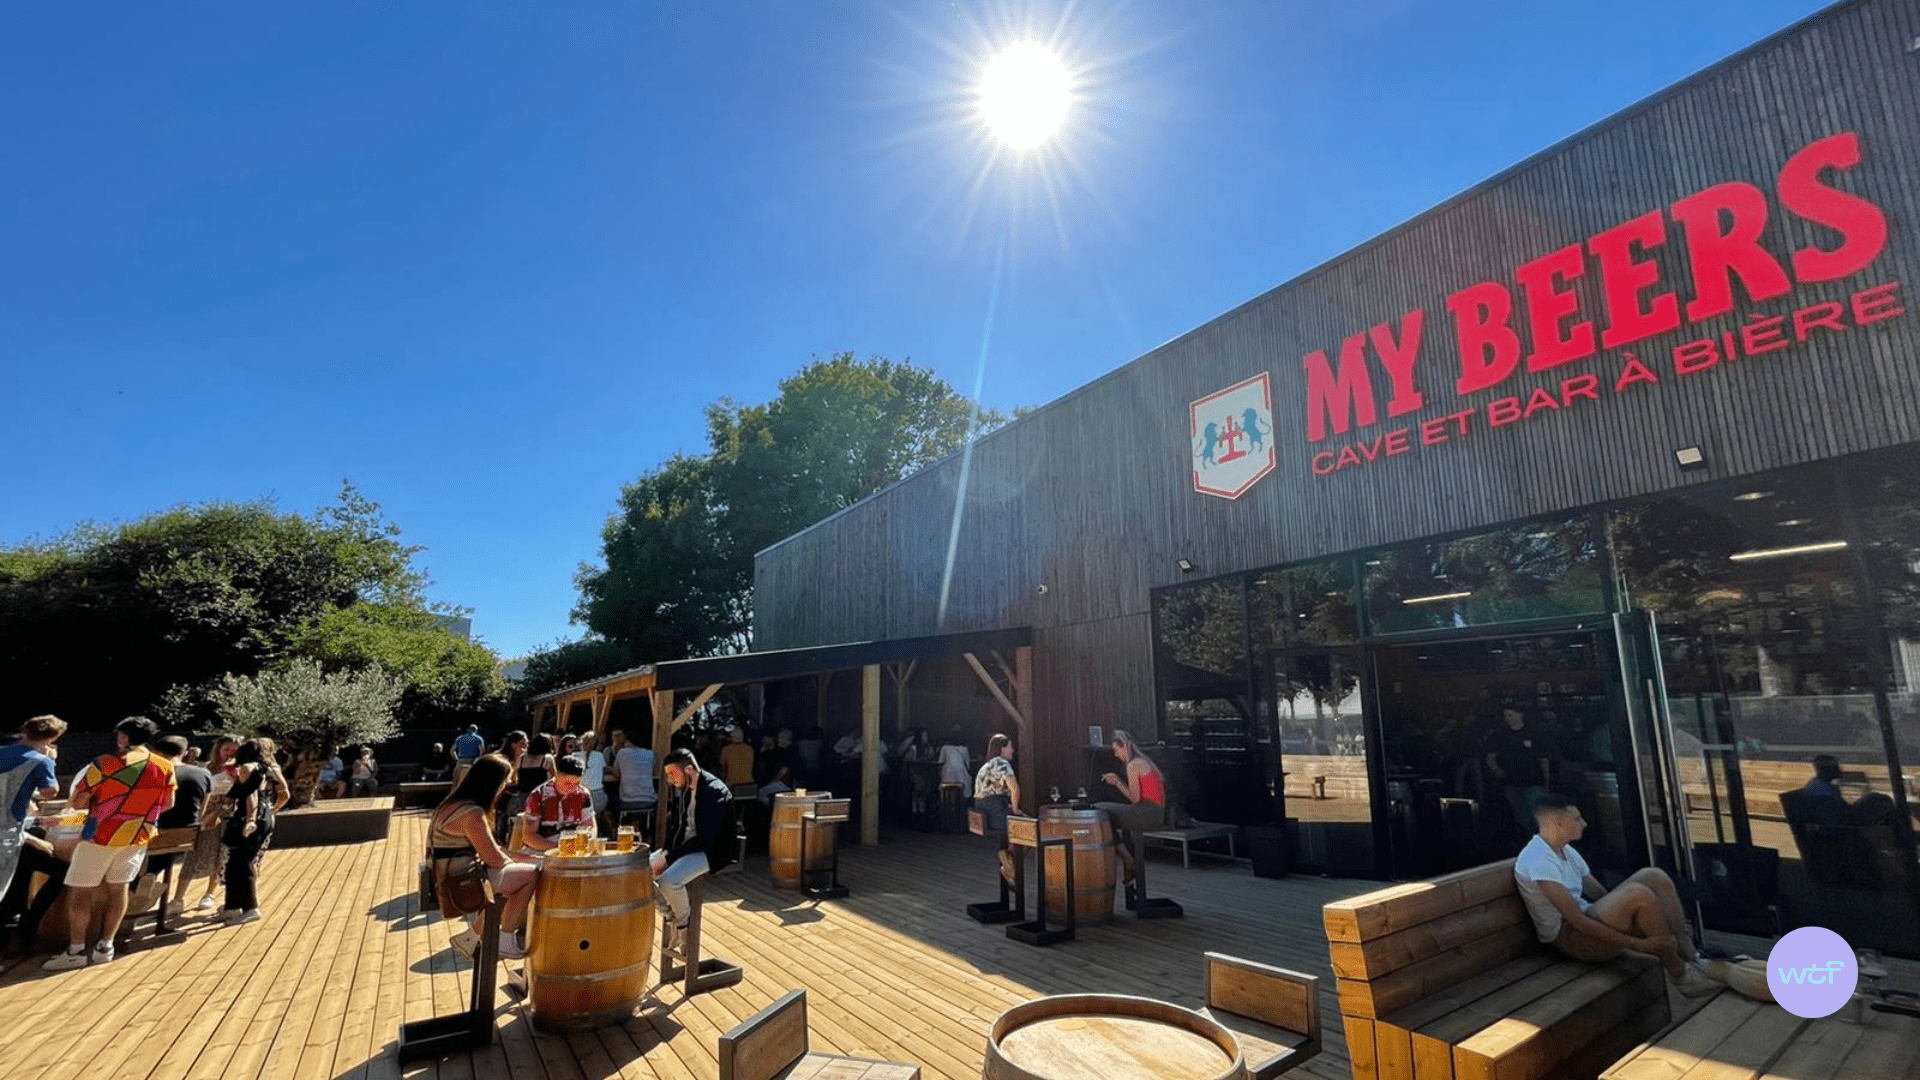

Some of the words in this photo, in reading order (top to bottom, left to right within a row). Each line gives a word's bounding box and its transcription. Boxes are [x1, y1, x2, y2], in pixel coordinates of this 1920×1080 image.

[1303, 308, 1426, 443] MY
[1446, 131, 1889, 397] BEERS
[1311, 426, 1411, 476] CAVE
[1421, 407, 1477, 448] ET
[1487, 373, 1601, 429] BAR
[1614, 350, 1659, 394] À
[1672, 282, 1905, 377] BIÈRE
